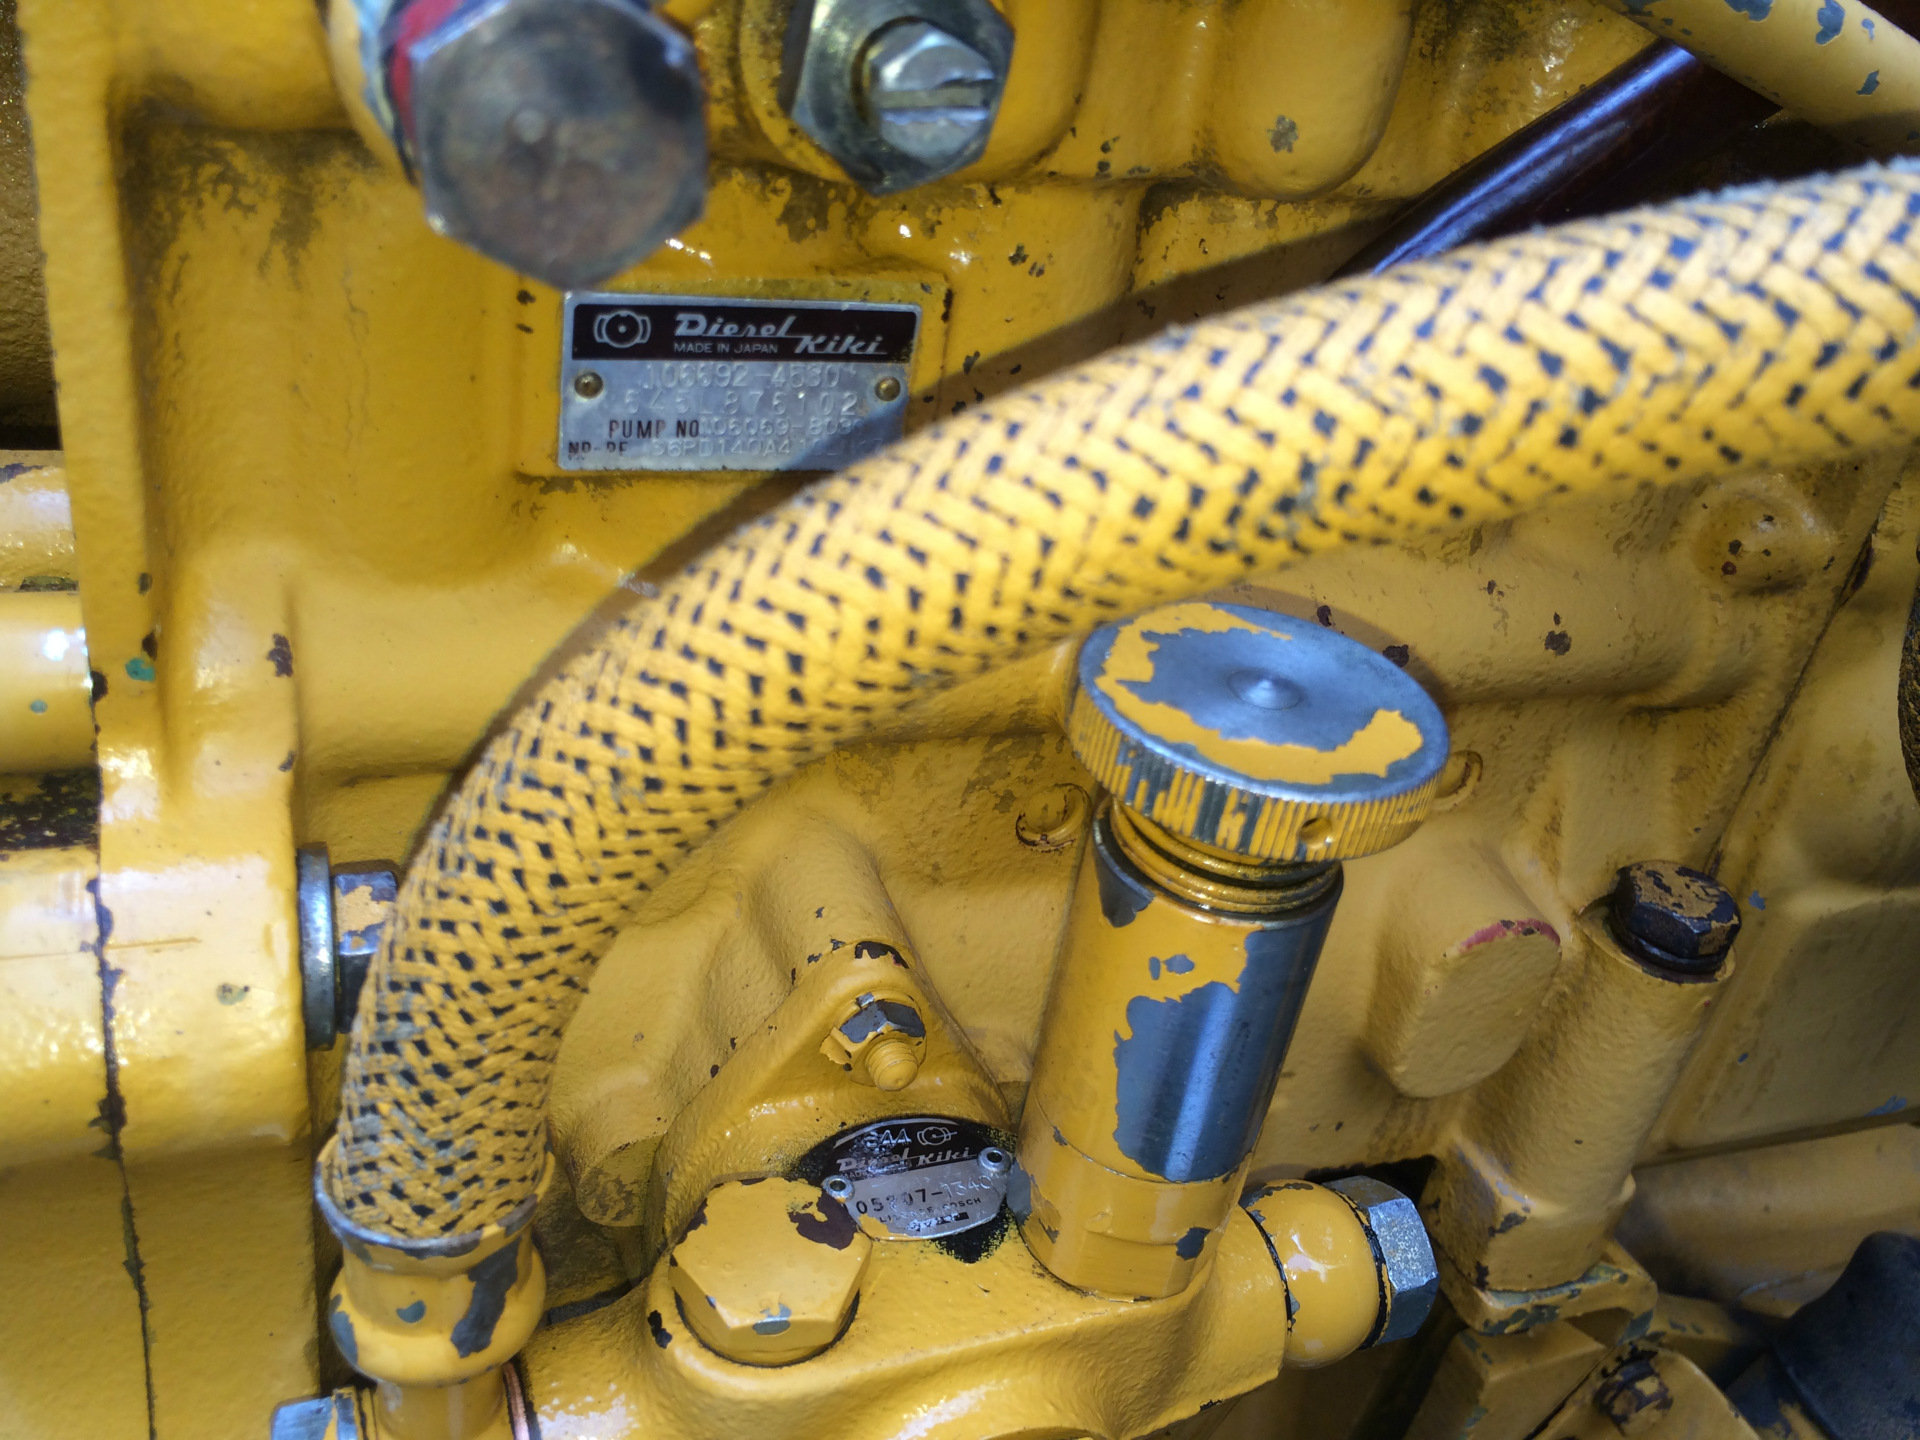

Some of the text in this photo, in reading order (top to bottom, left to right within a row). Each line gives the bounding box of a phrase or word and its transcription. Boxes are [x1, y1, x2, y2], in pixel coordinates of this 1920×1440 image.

[674, 313, 888, 355] Diesel Kiki
[673, 342, 779, 355] MADE IN JAPAN
[608, 418, 666, 439] PUMP
[676, 418, 700, 439] NO
[917, 1146, 978, 1166] Kiki
